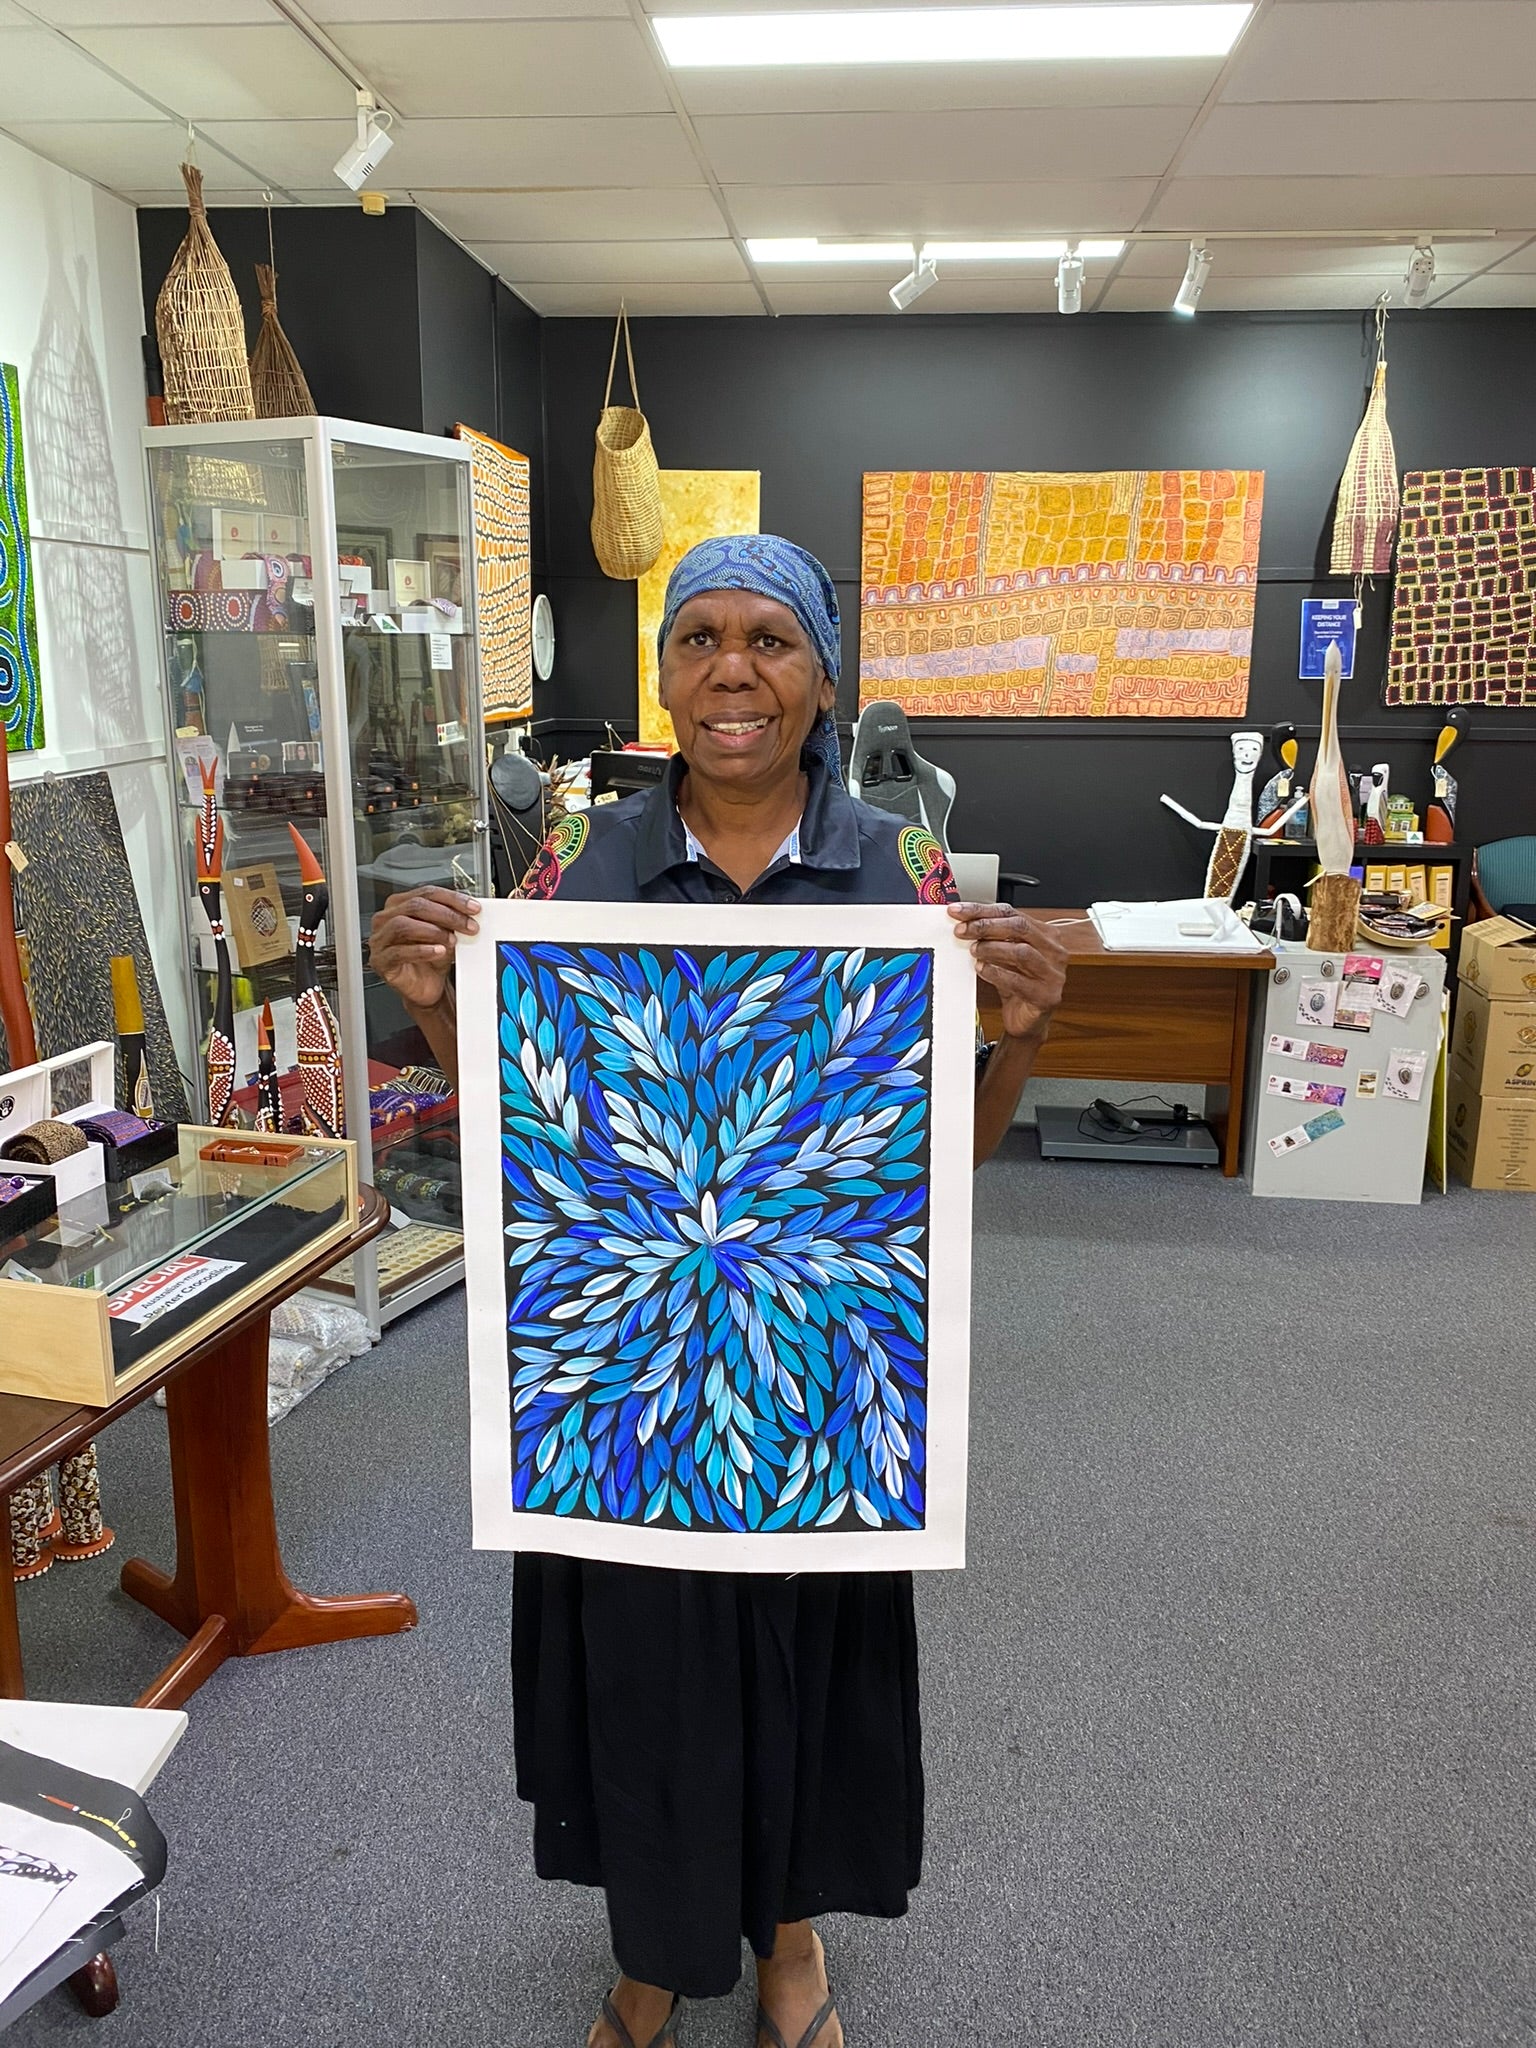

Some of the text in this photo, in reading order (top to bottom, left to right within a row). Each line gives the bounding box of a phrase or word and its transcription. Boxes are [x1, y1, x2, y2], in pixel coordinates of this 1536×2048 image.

[107, 1259, 199, 1312] SPECIAL
[141, 1267, 208, 1309] Australian-made
[181, 1264, 233, 1294] Crocodiles
